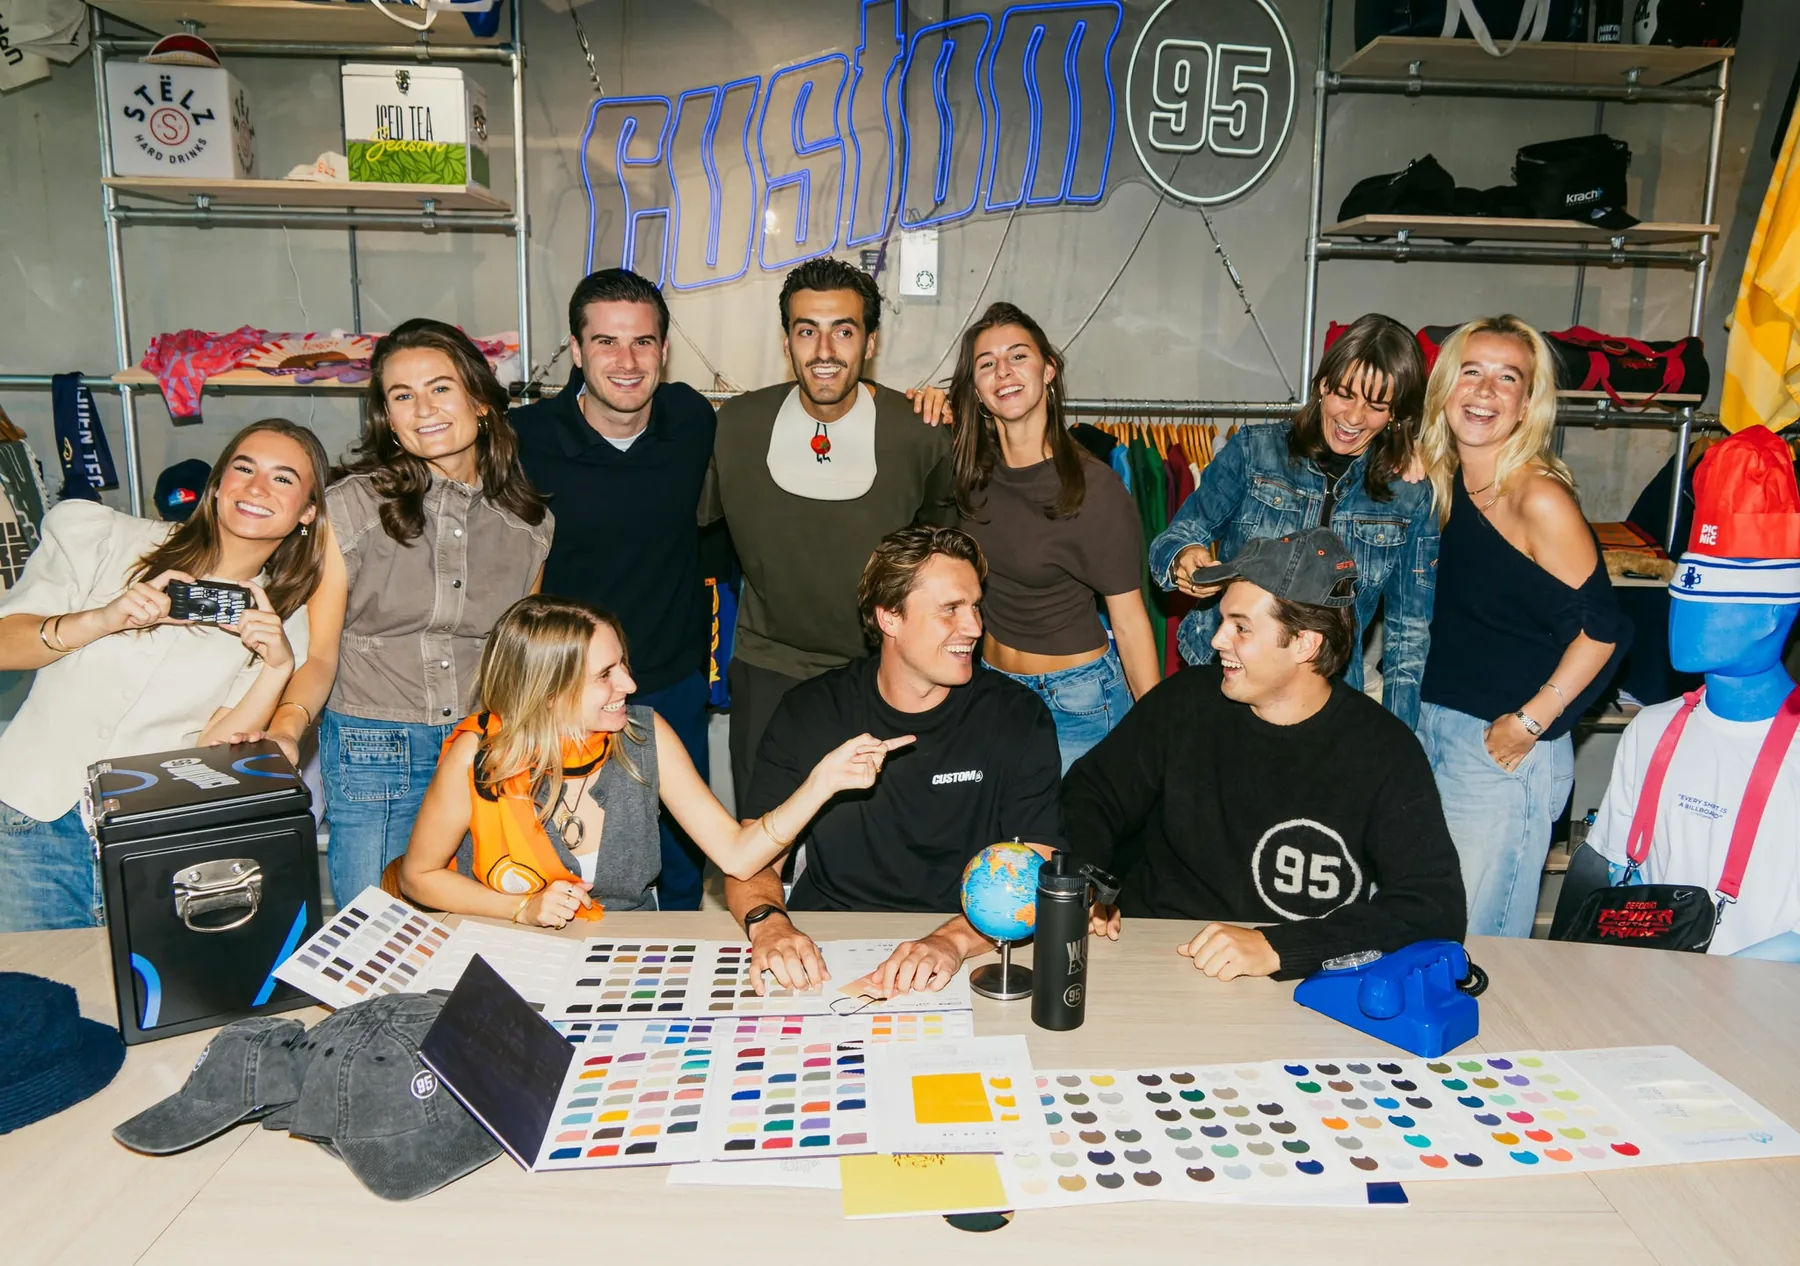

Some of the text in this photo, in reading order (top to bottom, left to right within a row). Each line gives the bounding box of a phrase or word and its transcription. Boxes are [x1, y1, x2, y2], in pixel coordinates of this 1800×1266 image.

[123, 75, 215, 126] STËLZ
[1149, 39, 1271, 155] 95
[376, 104, 433, 142] ICED TEA
[134, 134, 163, 161] HARD
[169, 138, 207, 164] DRINKS
[366, 126, 447, 162] Season
[932, 770, 977, 785] CUSTOM
[1274, 845, 1341, 899] 95
[1599, 909, 1674, 925] POWER
[1069, 988, 1080, 1003] 95
[416, 1074, 433, 1094] 95
